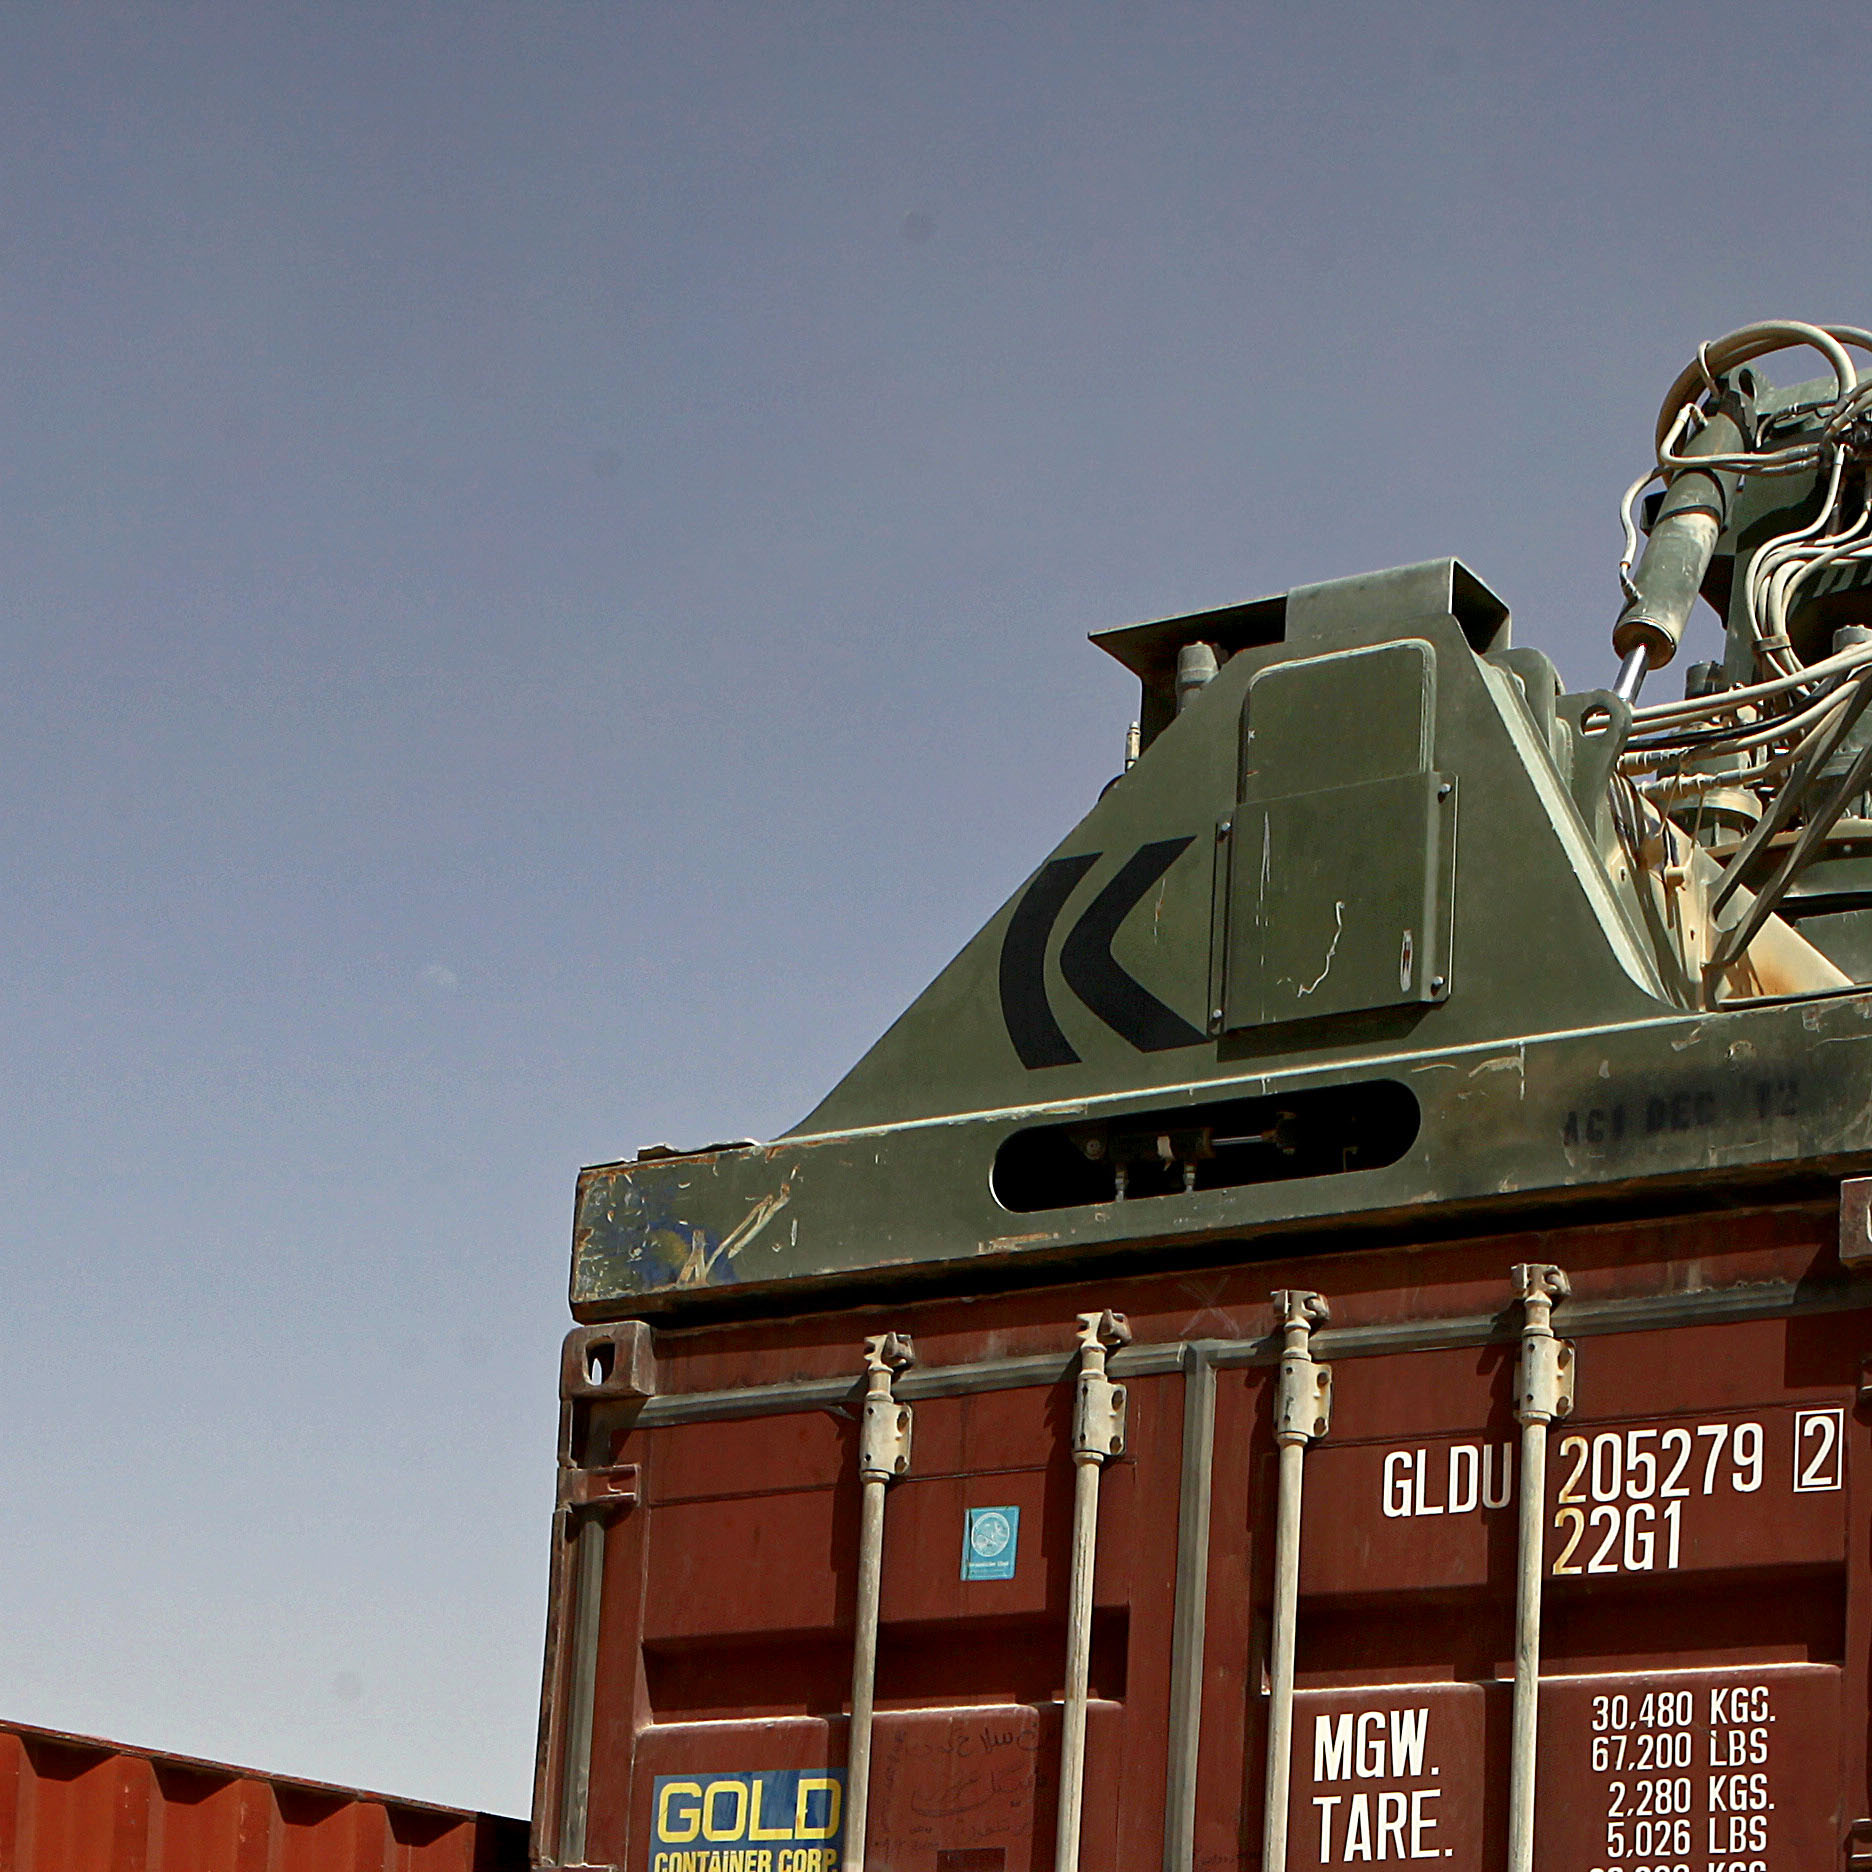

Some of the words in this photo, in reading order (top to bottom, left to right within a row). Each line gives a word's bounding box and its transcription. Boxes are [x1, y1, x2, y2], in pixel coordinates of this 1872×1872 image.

[1383, 1441, 1512, 1518] GLDU
[1558, 1421, 1764, 1504] 205279
[1801, 1414, 1837, 1486] 2
[1552, 1500, 1681, 1576] 22G1
[1592, 1690, 1693, 1731] 30,480
[1709, 1686, 1776, 1724] KGS.
[1313, 1708, 1439, 1782] MGW.
[1592, 1731, 1692, 1773] 67,200
[1709, 1728, 1768, 1767] LBS
[657, 1778, 842, 1844] GOLD
[1313, 1789, 1454, 1864] TARE.
[1608, 1777, 1691, 1818] 2,280
[1708, 1773, 1776, 1811] KGS.
[1607, 1818, 1691, 1859] 5,026
[1708, 1815, 1767, 1854] LBS
